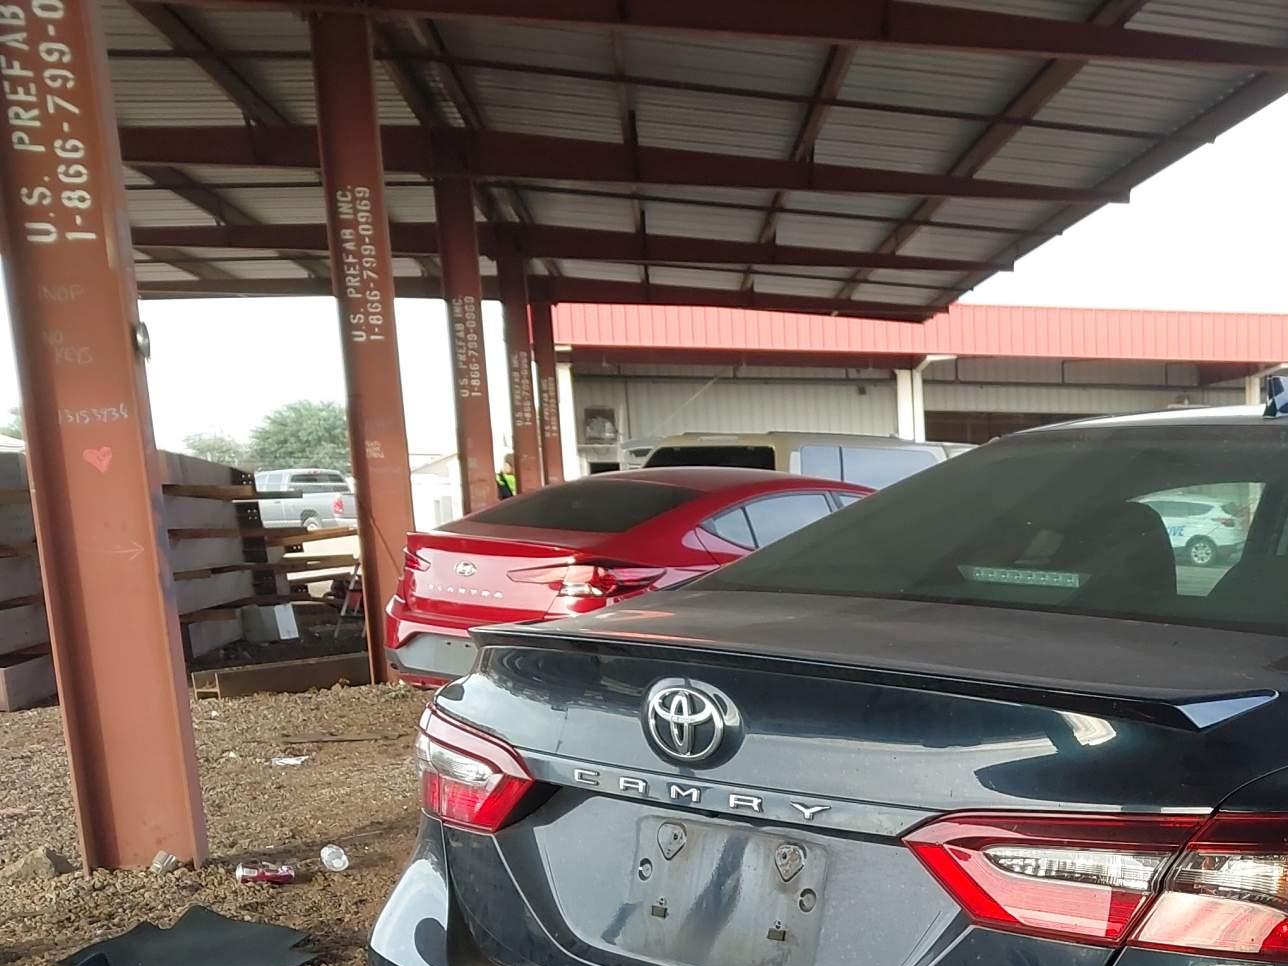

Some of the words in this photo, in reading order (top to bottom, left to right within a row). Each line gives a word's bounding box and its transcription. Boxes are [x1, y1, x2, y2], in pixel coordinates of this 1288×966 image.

[0, 4, 46, 152] PREFAB
[20, 176, 58, 243] U.S.
[336, 184, 355, 219] INC.
[340, 228, 363, 298] PREFAB
[354, 187, 385, 340] 1-866-799-0969
[350, 308, 367, 342] U.S.
[573, 768, 832, 820] CAMRY
